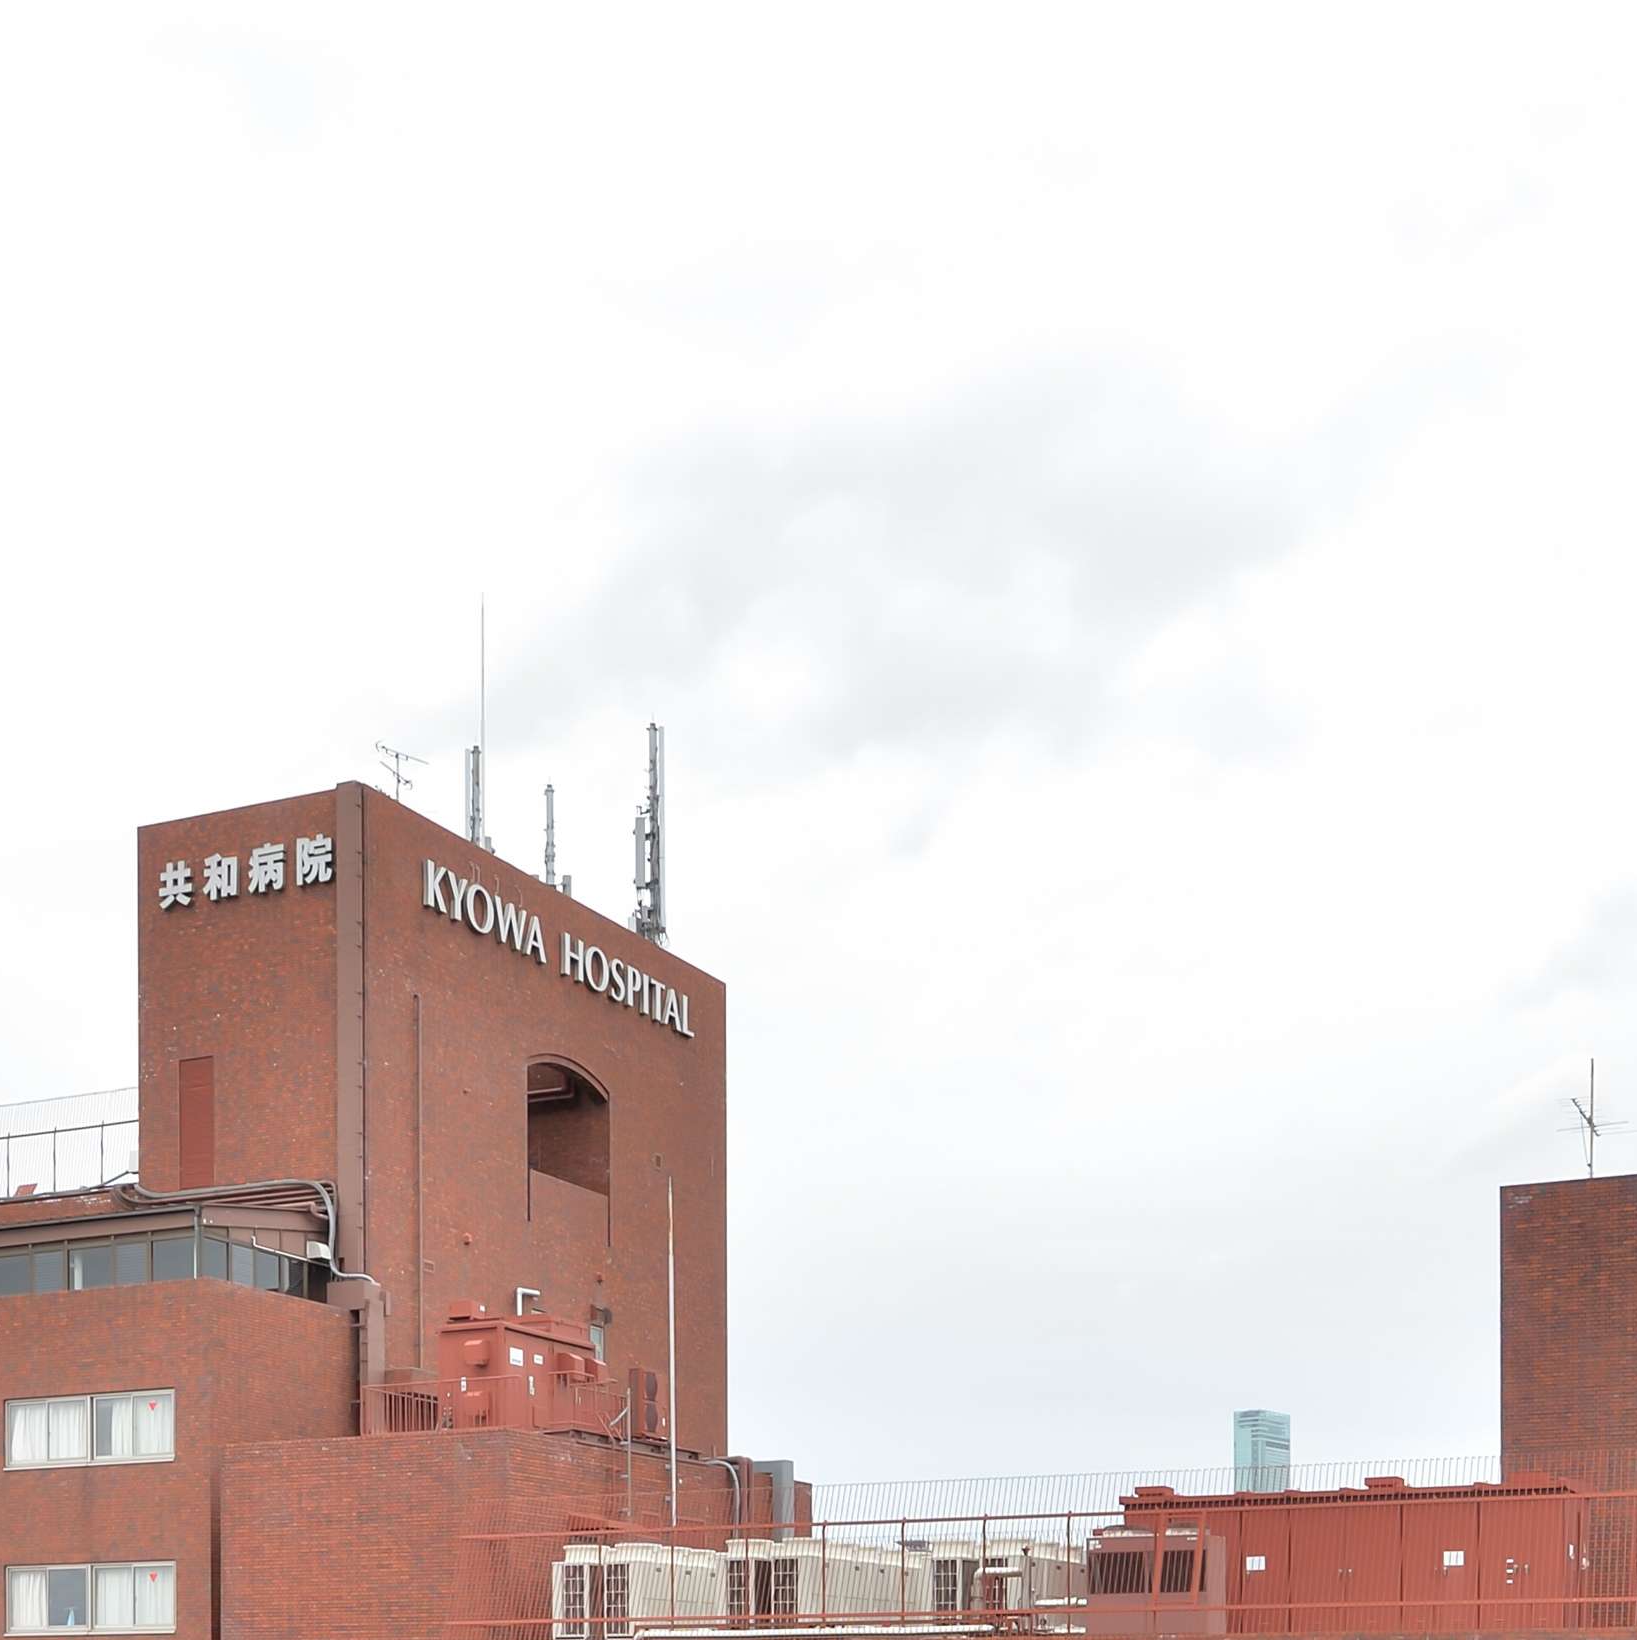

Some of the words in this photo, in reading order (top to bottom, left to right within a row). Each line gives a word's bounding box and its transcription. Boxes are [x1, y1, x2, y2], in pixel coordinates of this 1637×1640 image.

[158, 833, 333, 910] 共和病院
[422, 859, 547, 964] KYOWA
[560, 931, 695, 1038] HOSPITAL
